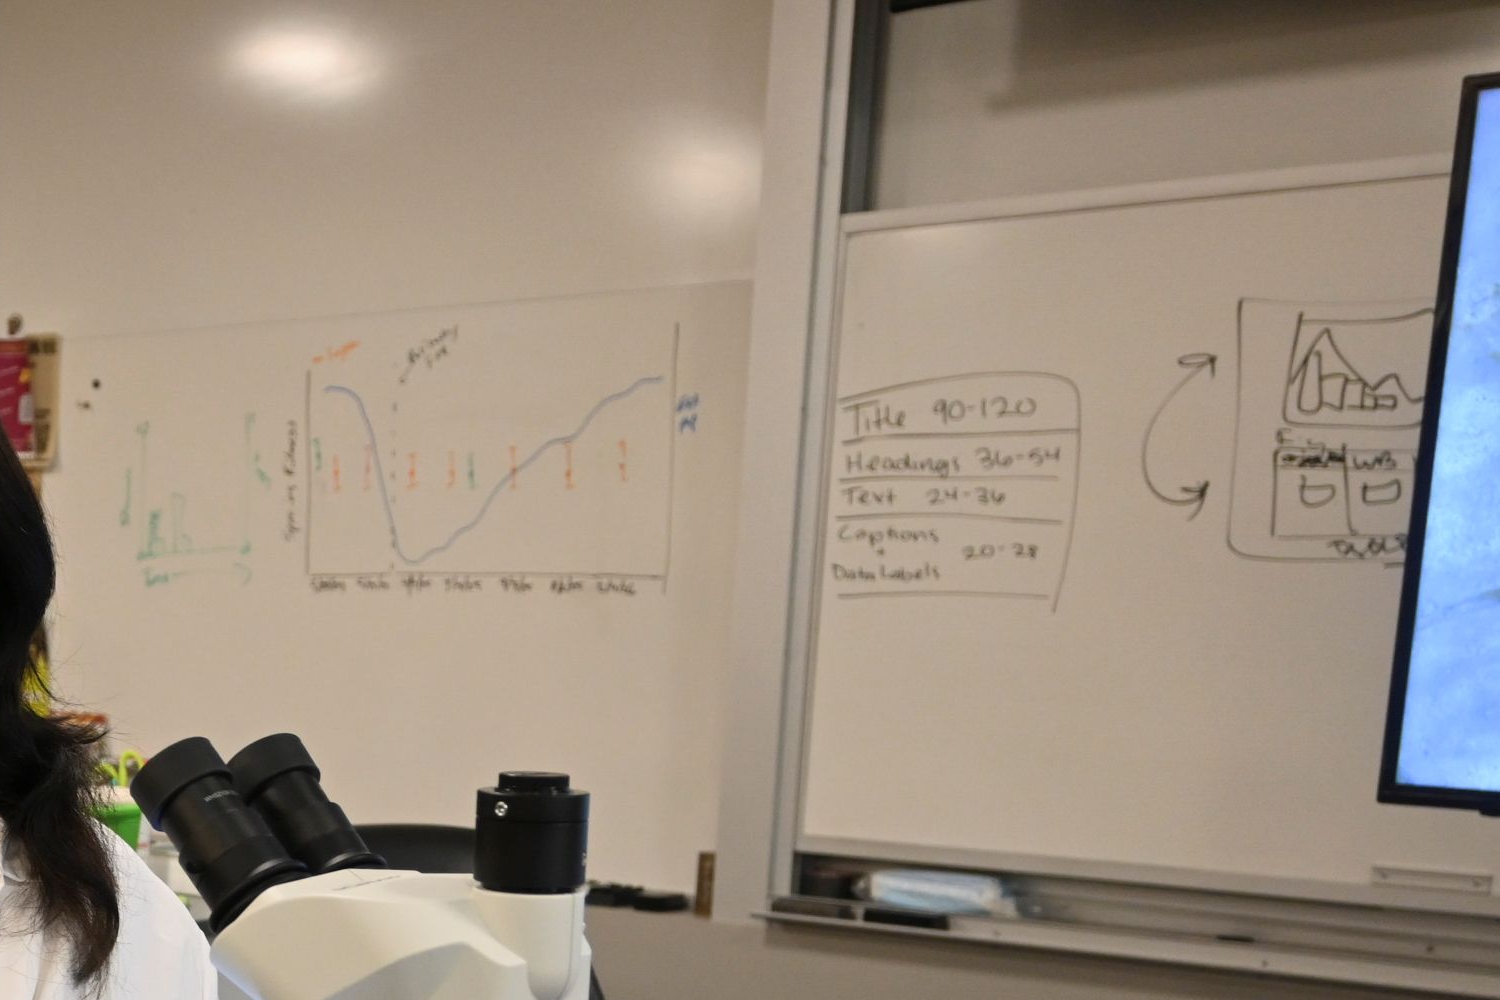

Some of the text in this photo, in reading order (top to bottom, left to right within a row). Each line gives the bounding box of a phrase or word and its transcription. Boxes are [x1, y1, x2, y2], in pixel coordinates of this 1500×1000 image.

[841, 396, 1037, 435] Title 90-120
[845, 446, 1061, 479] Headings 36-54
[840, 486, 898, 505] Text
[836, 523, 941, 547] Captions
